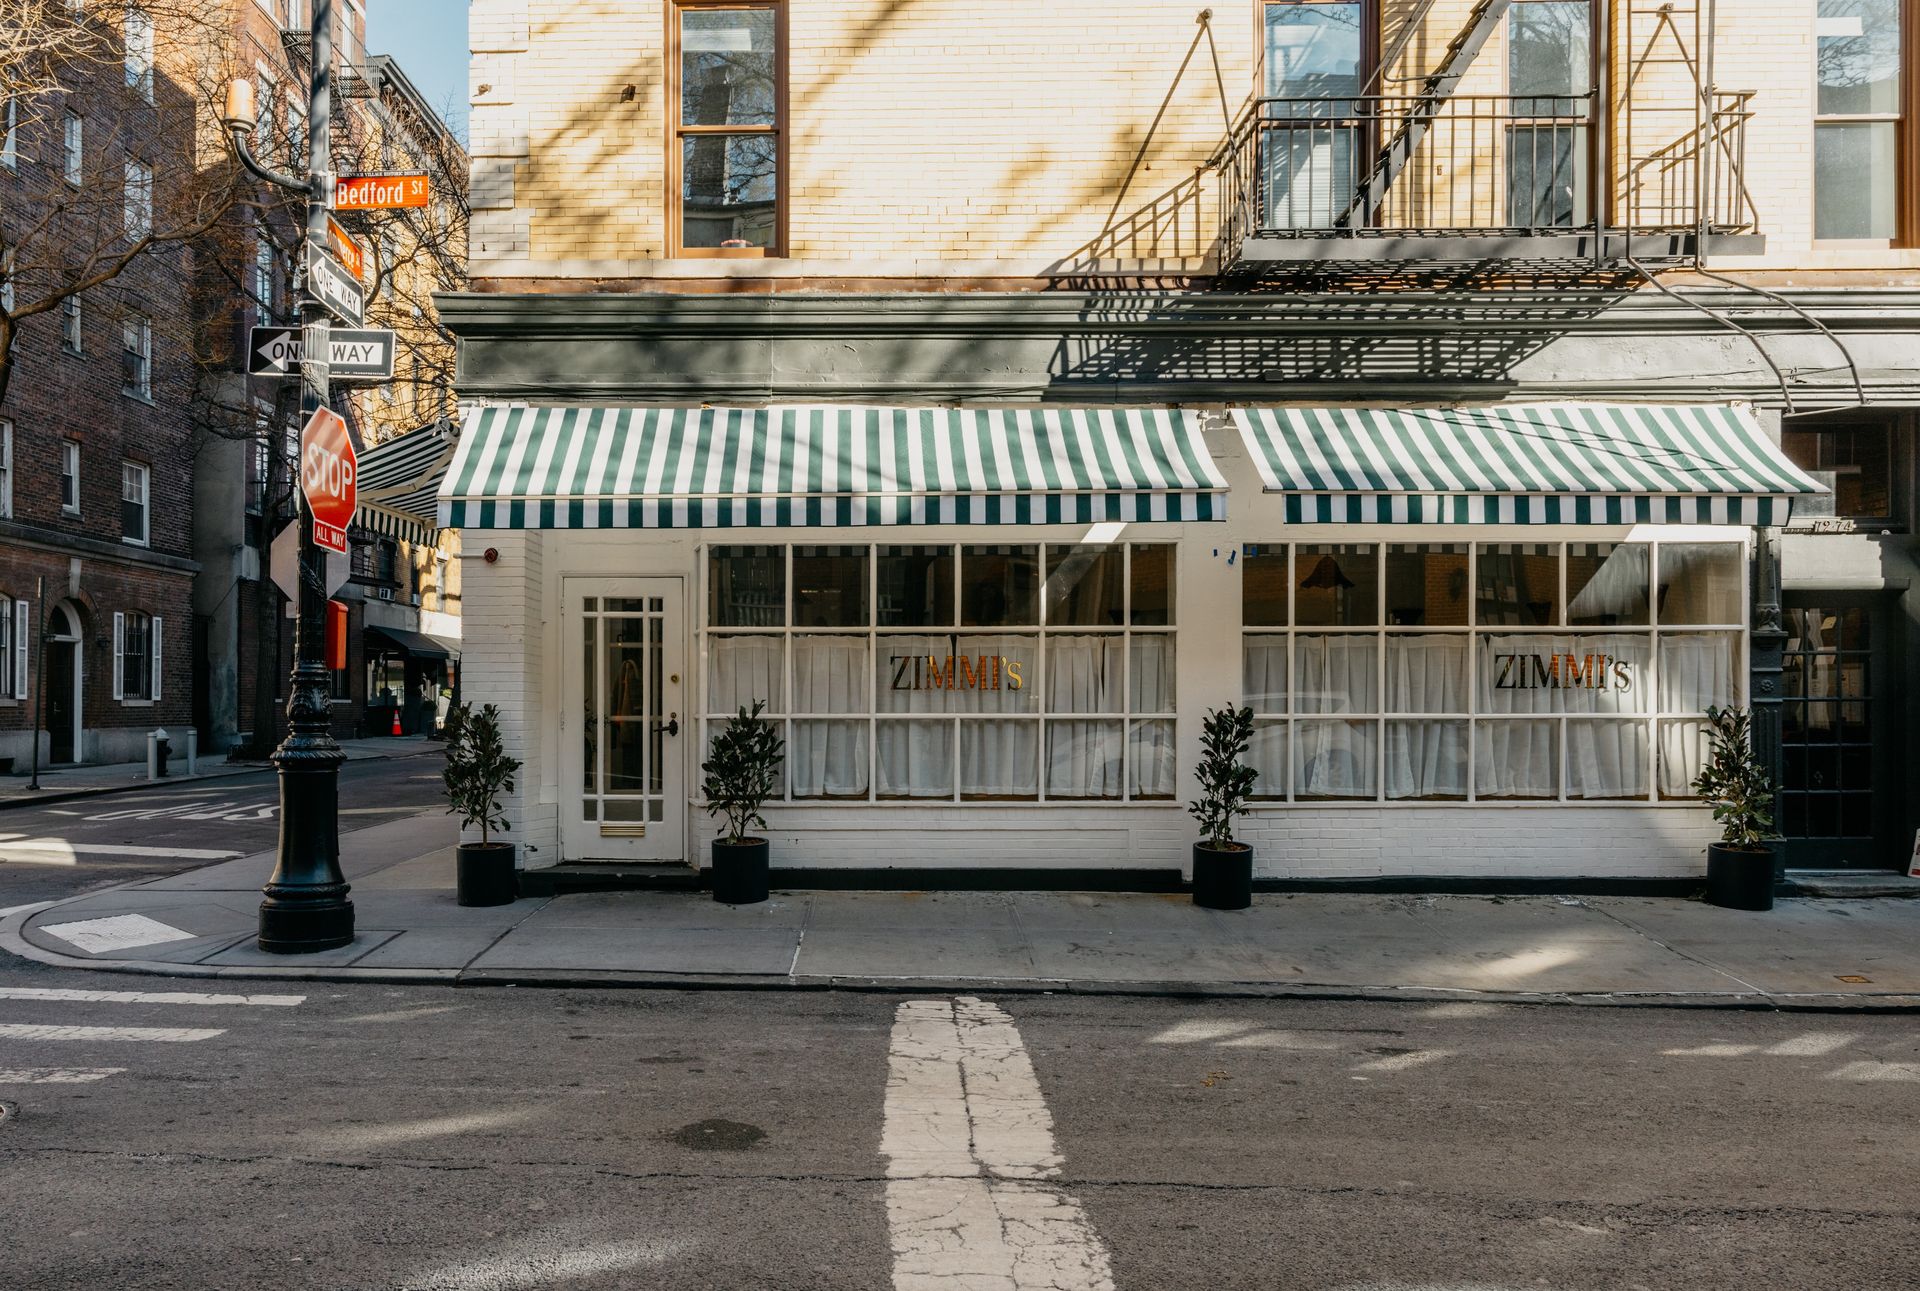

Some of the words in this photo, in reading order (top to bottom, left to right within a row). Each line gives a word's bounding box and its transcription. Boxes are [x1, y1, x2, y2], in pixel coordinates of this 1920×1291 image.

[338, 180, 403, 205] Bedford
[411, 180, 423, 195] St
[317, 266, 334, 294] ONE
[341, 284, 357, 312] WAY
[272, 343, 303, 360] ON
[332, 344, 374, 362] WAY
[306, 442, 353, 501] STOP
[316, 526, 329, 543] ALL
[331, 530, 345, 548] WAY
